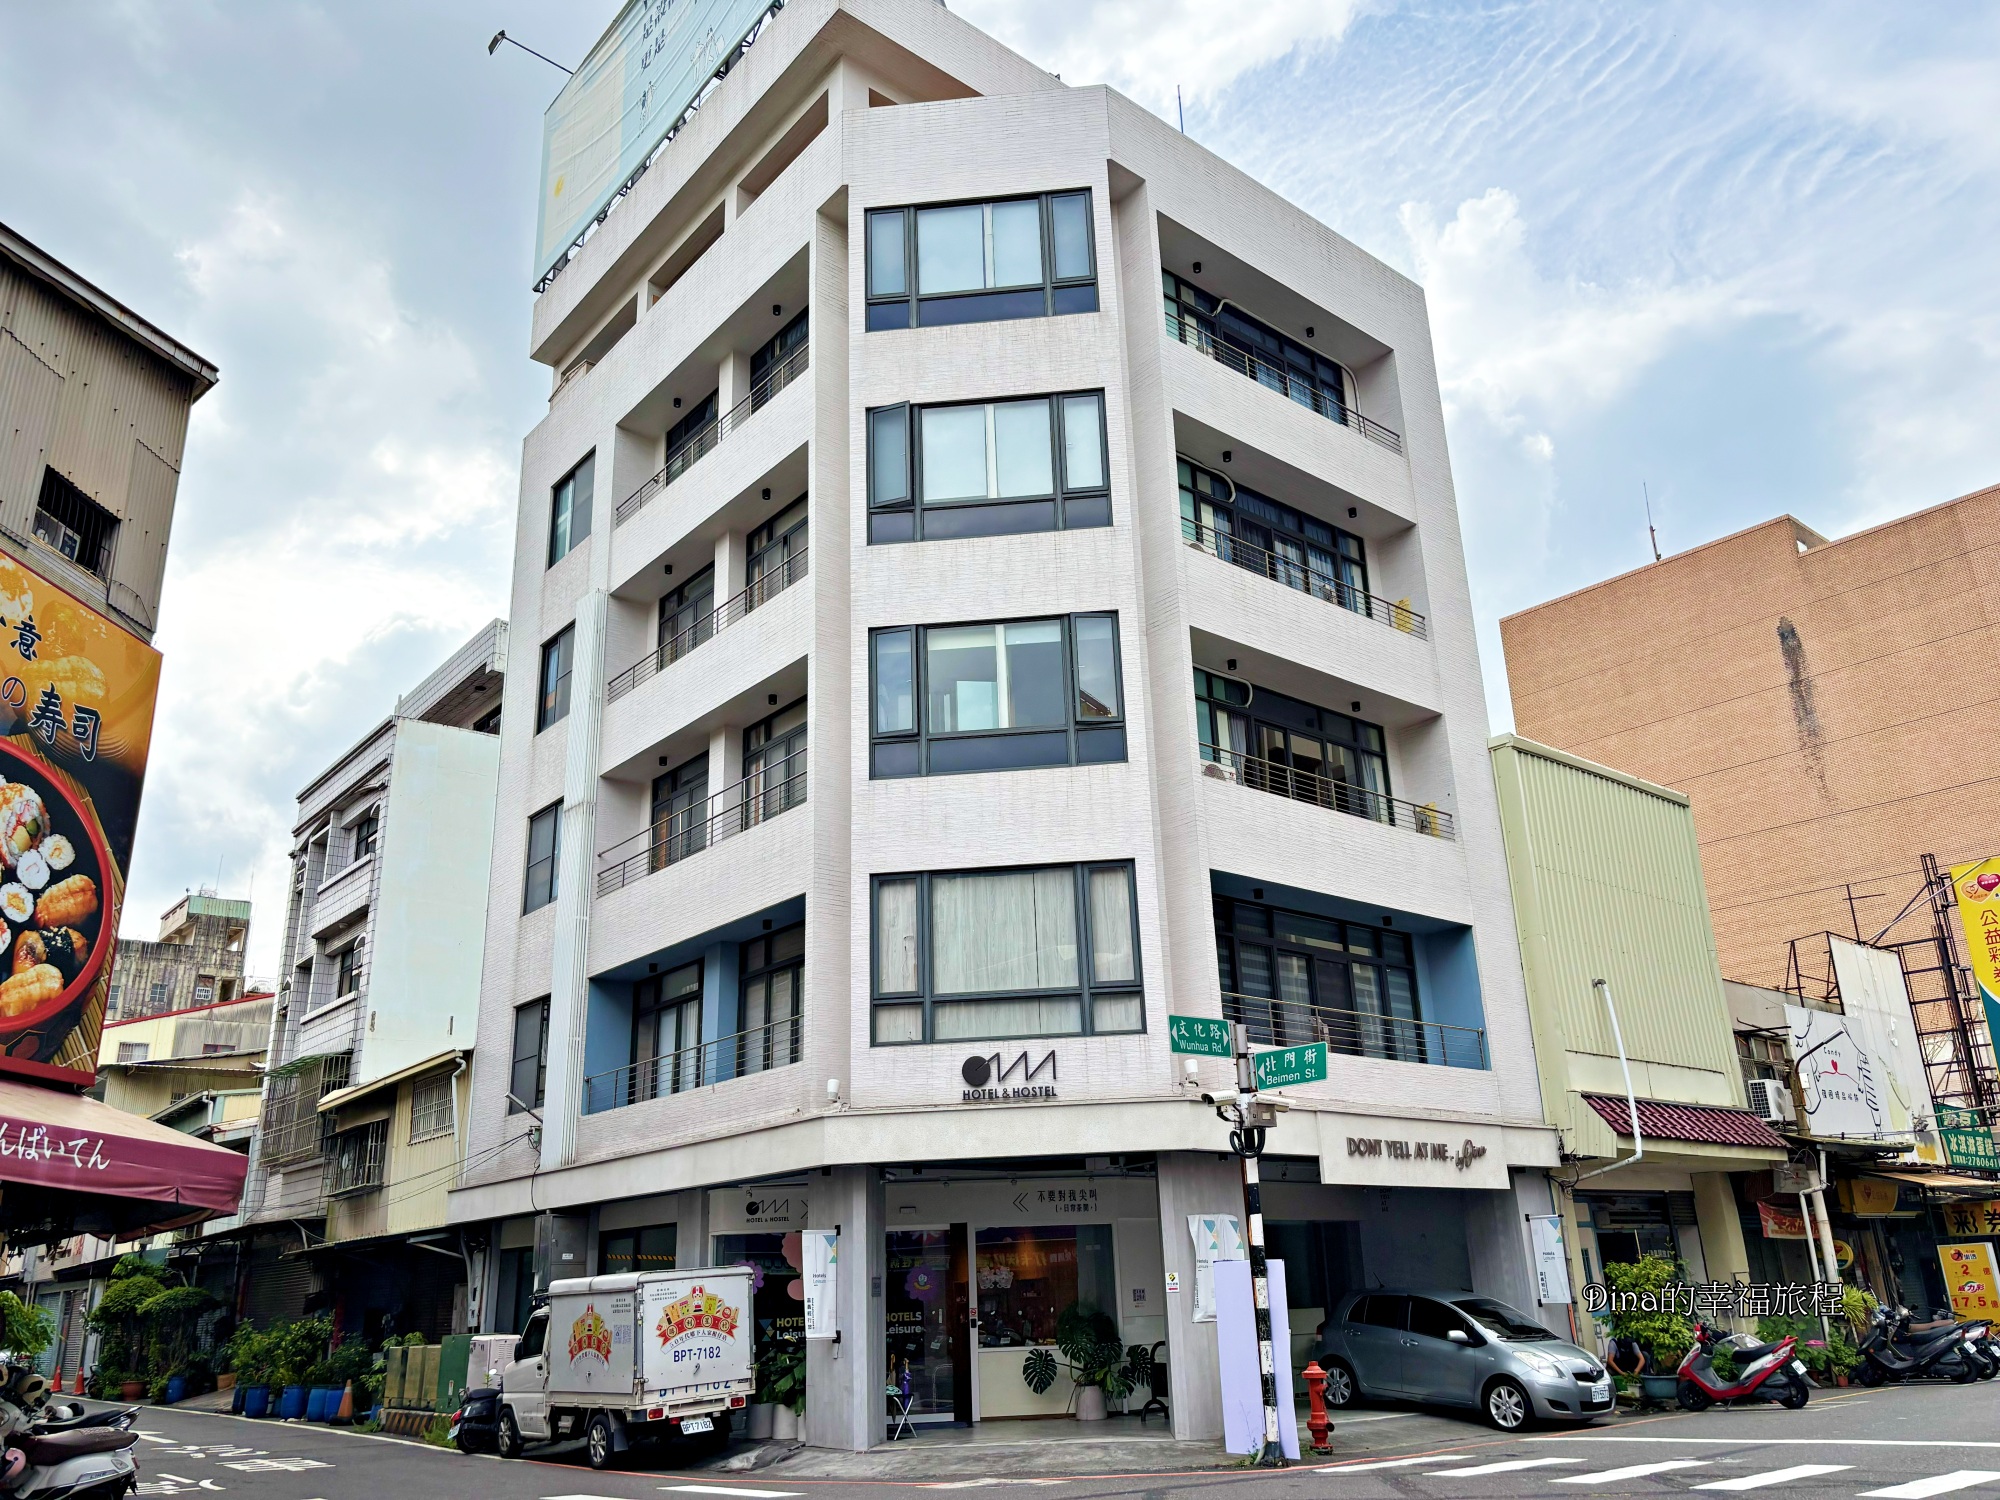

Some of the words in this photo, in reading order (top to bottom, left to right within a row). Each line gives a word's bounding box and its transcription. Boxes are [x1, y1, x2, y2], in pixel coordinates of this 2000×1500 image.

[0, 615, 42, 661] 意
[1178, 1020, 1222, 1039] 文化路
[1179, 1040, 1209, 1052] Wunhua
[1212, 1043, 1224, 1053] Rd.
[1265, 1048, 1318, 1073] 北門街
[1266, 1070, 1300, 1085] Beimen
[1305, 1068, 1318, 1079] St.
[962, 1088, 1000, 1100] HOTEL
[1002, 1087, 1010, 1098] &
[1013, 1086, 1058, 1098] HOSTEL
[1384, 1140, 1412, 1159] YELL
[1414, 1142, 1428, 1161] AT
[1948, 1133, 1995, 1157] 冰淇淋蛋糕
[1037, 1188, 1098, 1202] 不要對我尖叫
[1961, 1264, 1970, 1275] 2
[1952, 1296, 1987, 1308] 17.5
[673, 1346, 721, 1362] BPT-7182
